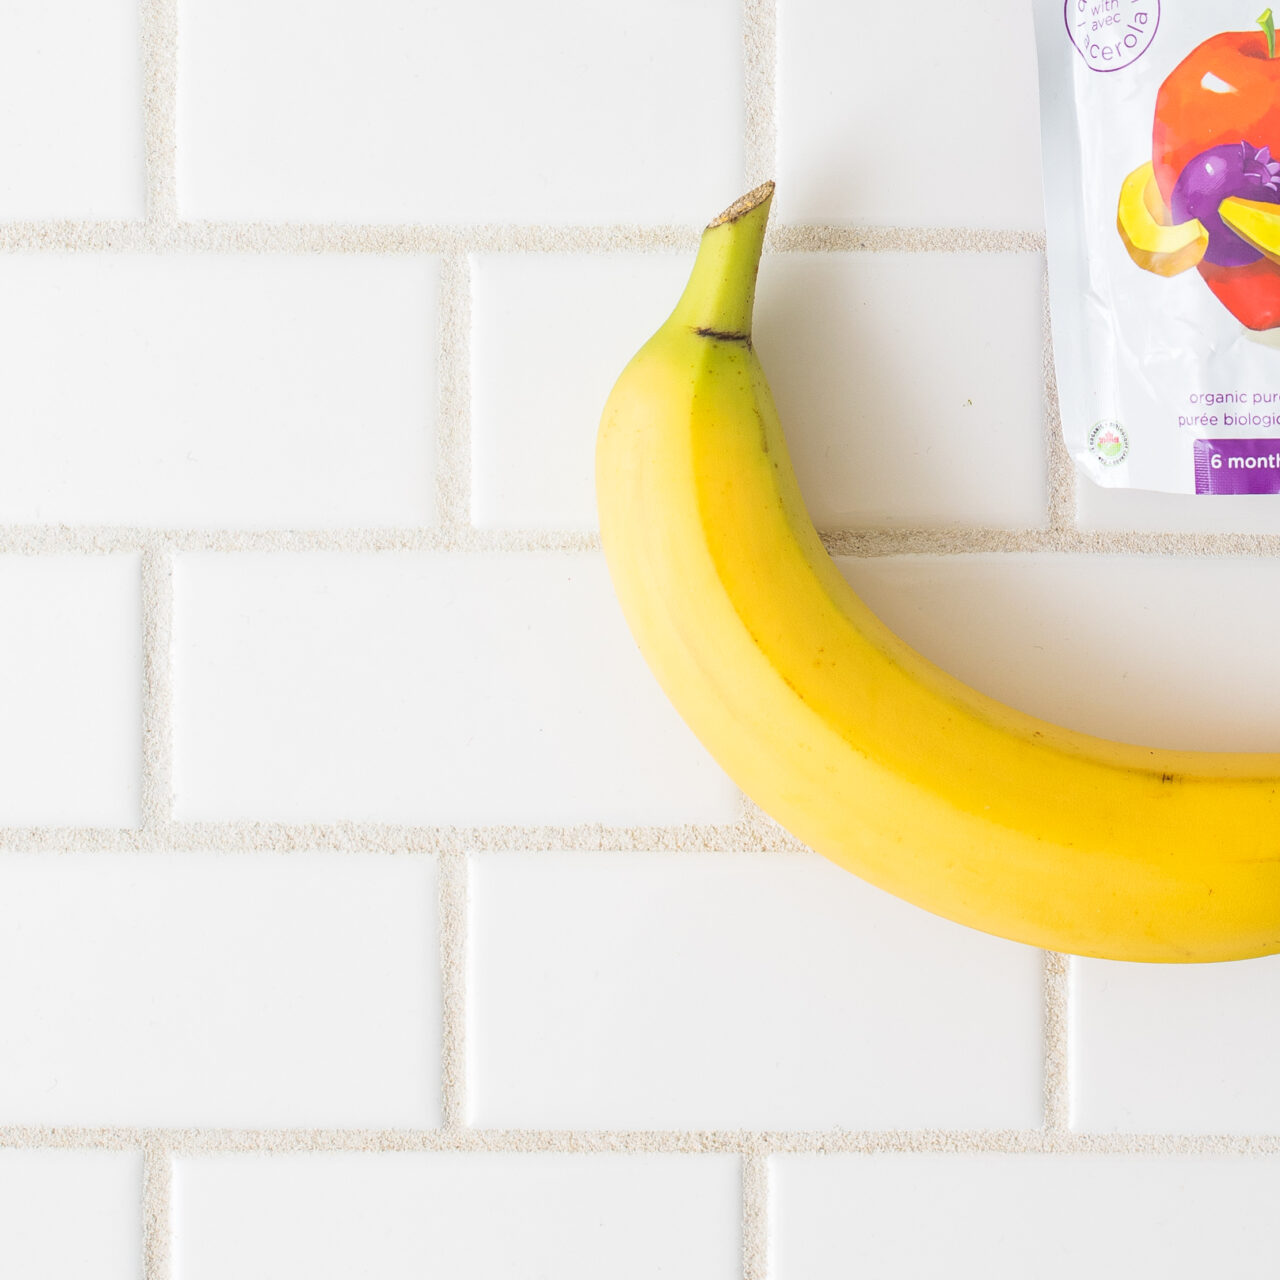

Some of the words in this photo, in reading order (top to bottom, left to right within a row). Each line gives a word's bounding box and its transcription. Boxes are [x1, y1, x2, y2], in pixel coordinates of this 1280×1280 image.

[1091, 13, 1121, 32] avec
[1189, 391, 1248, 406] organic
[1178, 412, 1219, 428] purée
[1211, 454, 1222, 469] 6
